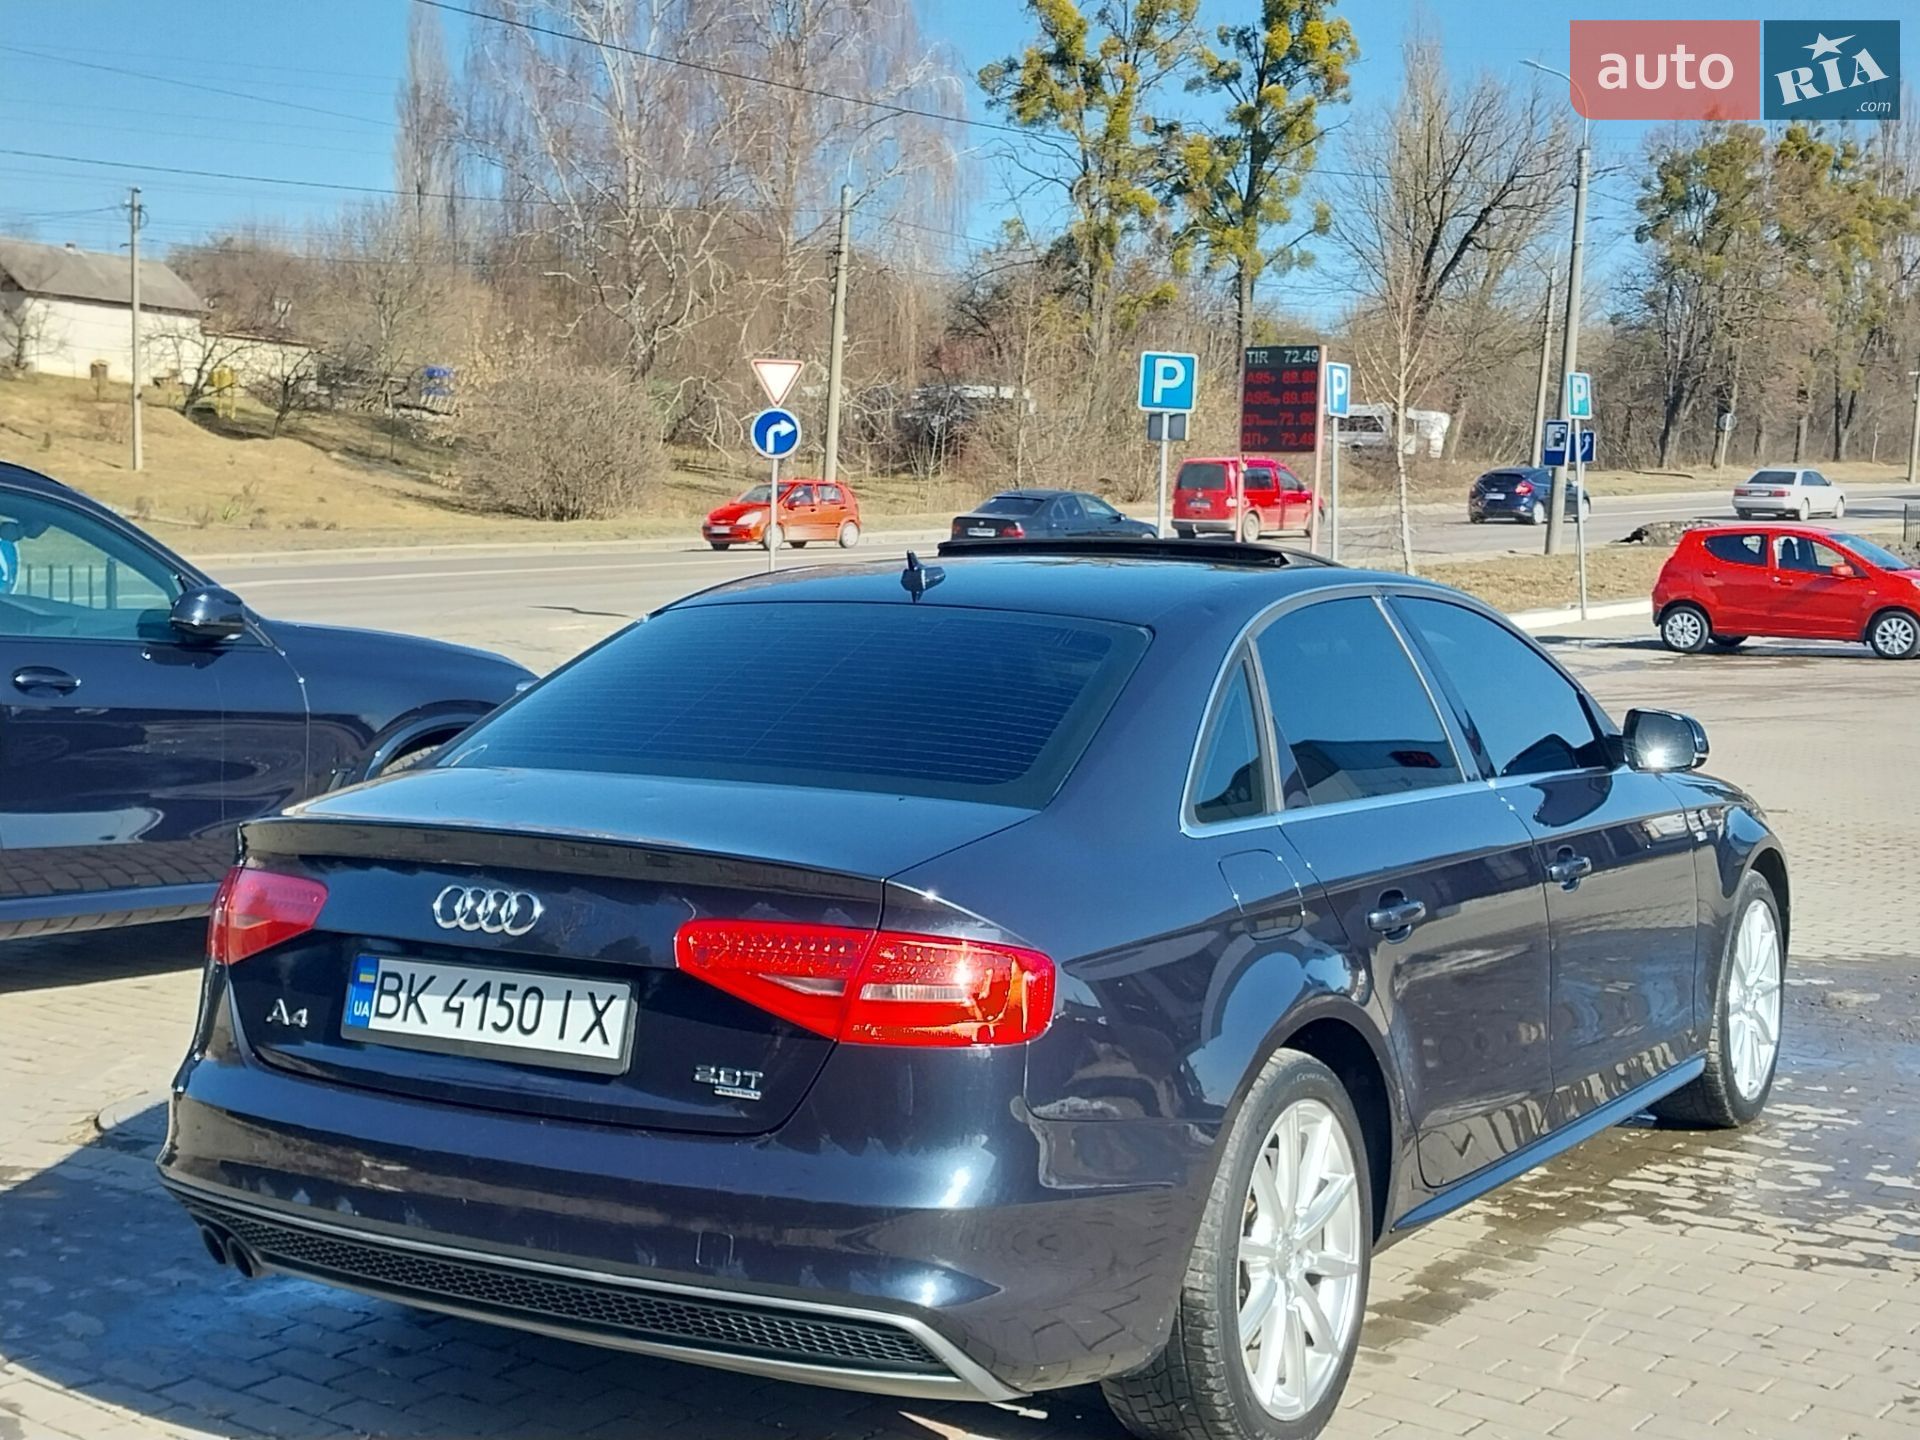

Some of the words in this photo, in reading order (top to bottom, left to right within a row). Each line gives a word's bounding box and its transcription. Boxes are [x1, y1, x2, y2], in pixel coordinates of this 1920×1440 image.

[1246, 350, 1269, 364] TIR
[1284, 349, 1319, 363] 72.49
[1152, 357, 1187, 404] P
[1332, 368, 1347, 410] P
[1571, 375, 1589, 414] P
[265, 998, 308, 1028] A4
[353, 1000, 370, 1018] UA
[374, 971, 437, 1025] BK
[442, 978, 544, 1036] 4150
